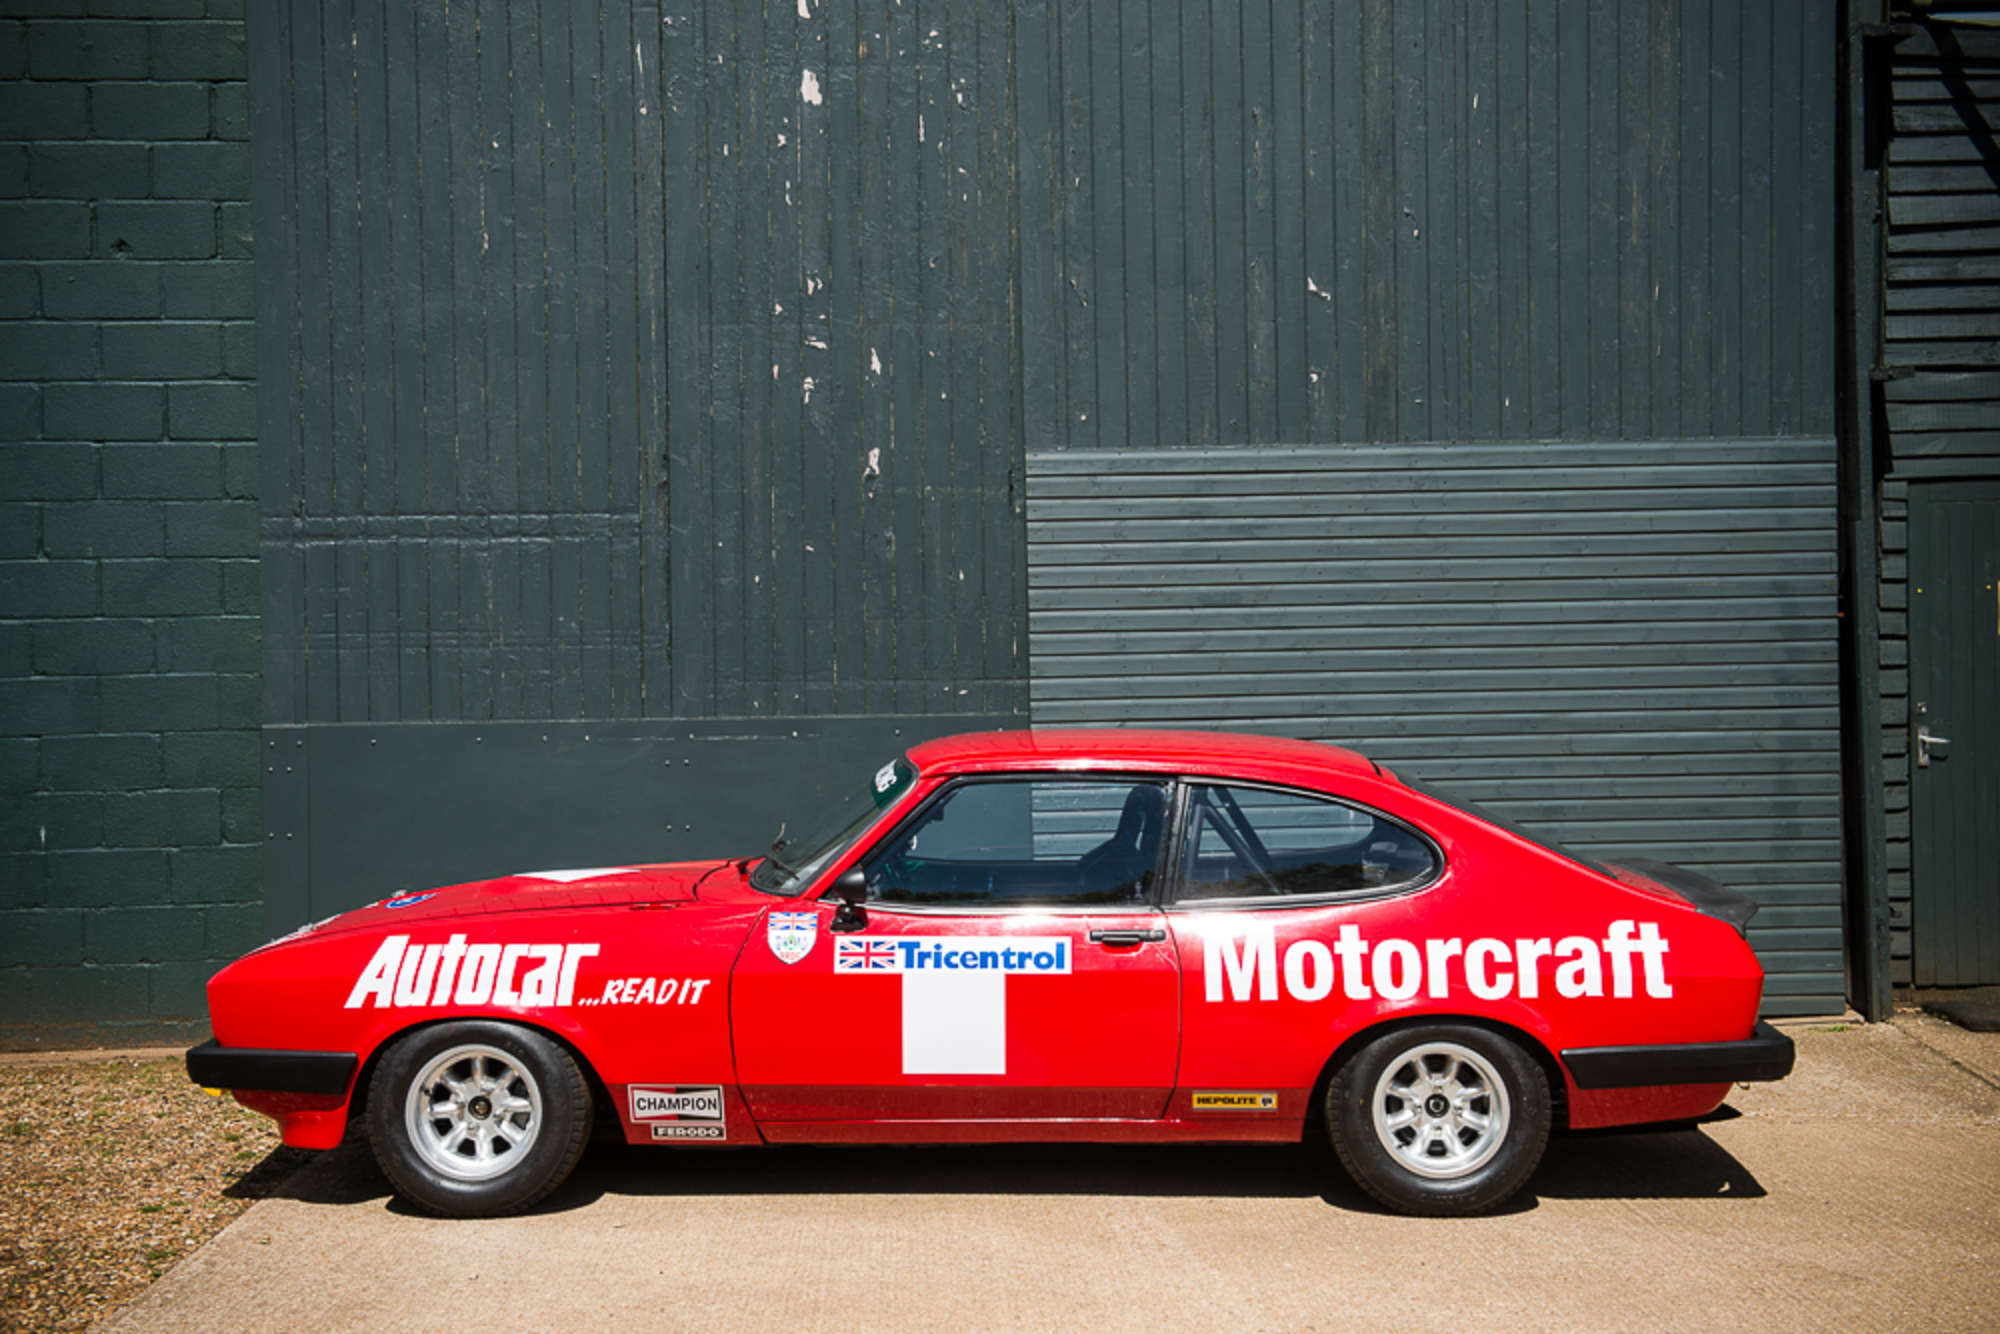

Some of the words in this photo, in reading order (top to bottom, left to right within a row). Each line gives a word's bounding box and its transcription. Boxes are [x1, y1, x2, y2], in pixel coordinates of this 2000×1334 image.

[898, 941, 1065, 969] Tricentrol
[1200, 919, 1673, 1002] Motorcraft
[344, 933, 600, 1008] Autocar
[635, 1097, 718, 1111] CHAMPION
[1196, 1096, 1257, 1105] HEPOLITE
[657, 1126, 720, 1137] FERODO
